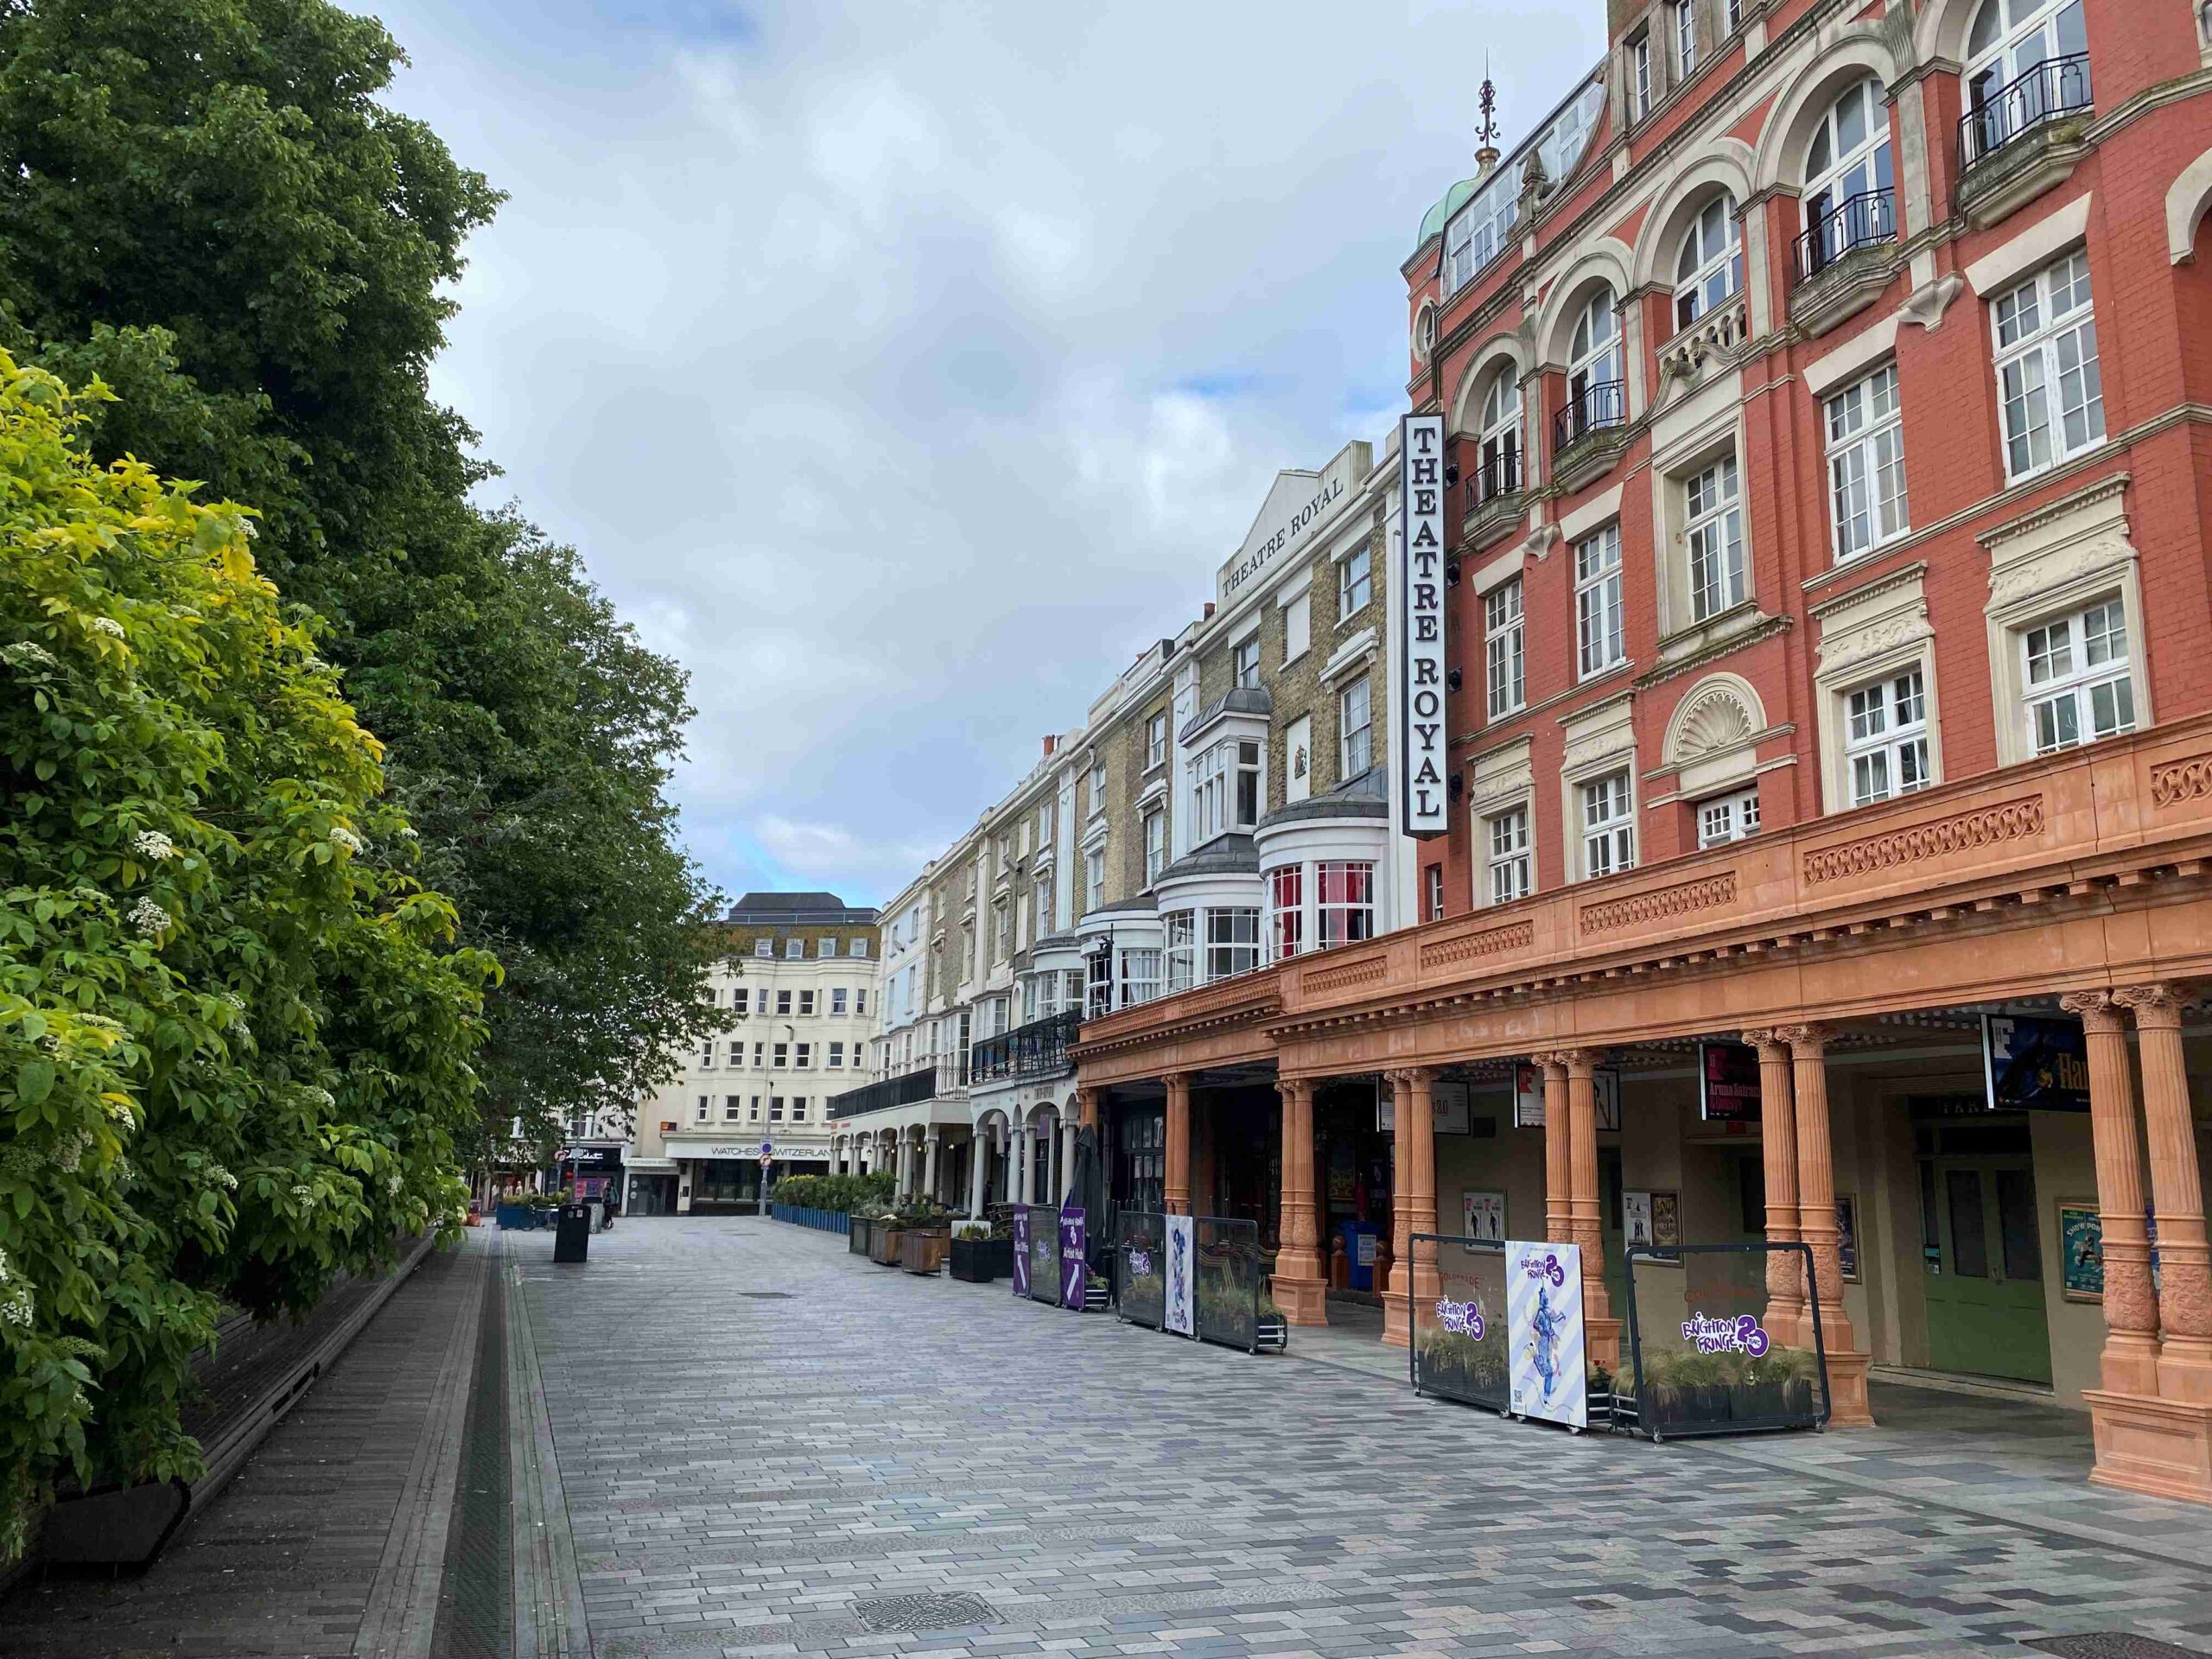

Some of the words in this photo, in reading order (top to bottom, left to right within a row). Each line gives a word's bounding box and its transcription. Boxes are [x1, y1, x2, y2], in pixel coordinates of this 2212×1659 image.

[1223, 528, 1285, 598] THEATRE
[1291, 477, 1344, 537] ROYAL
[1411, 428, 1439, 641] THEATRE
[1414, 658, 1441, 816] ROYAL
[1710, 1082, 1733, 1096] Aruna
[711, 1147, 760, 1156] WATCHES
[772, 1147, 830, 1157] SWITZERLAN
[2087, 1222, 2101, 1233] PON
[1681, 1313, 1736, 1339] BRIGHTON
